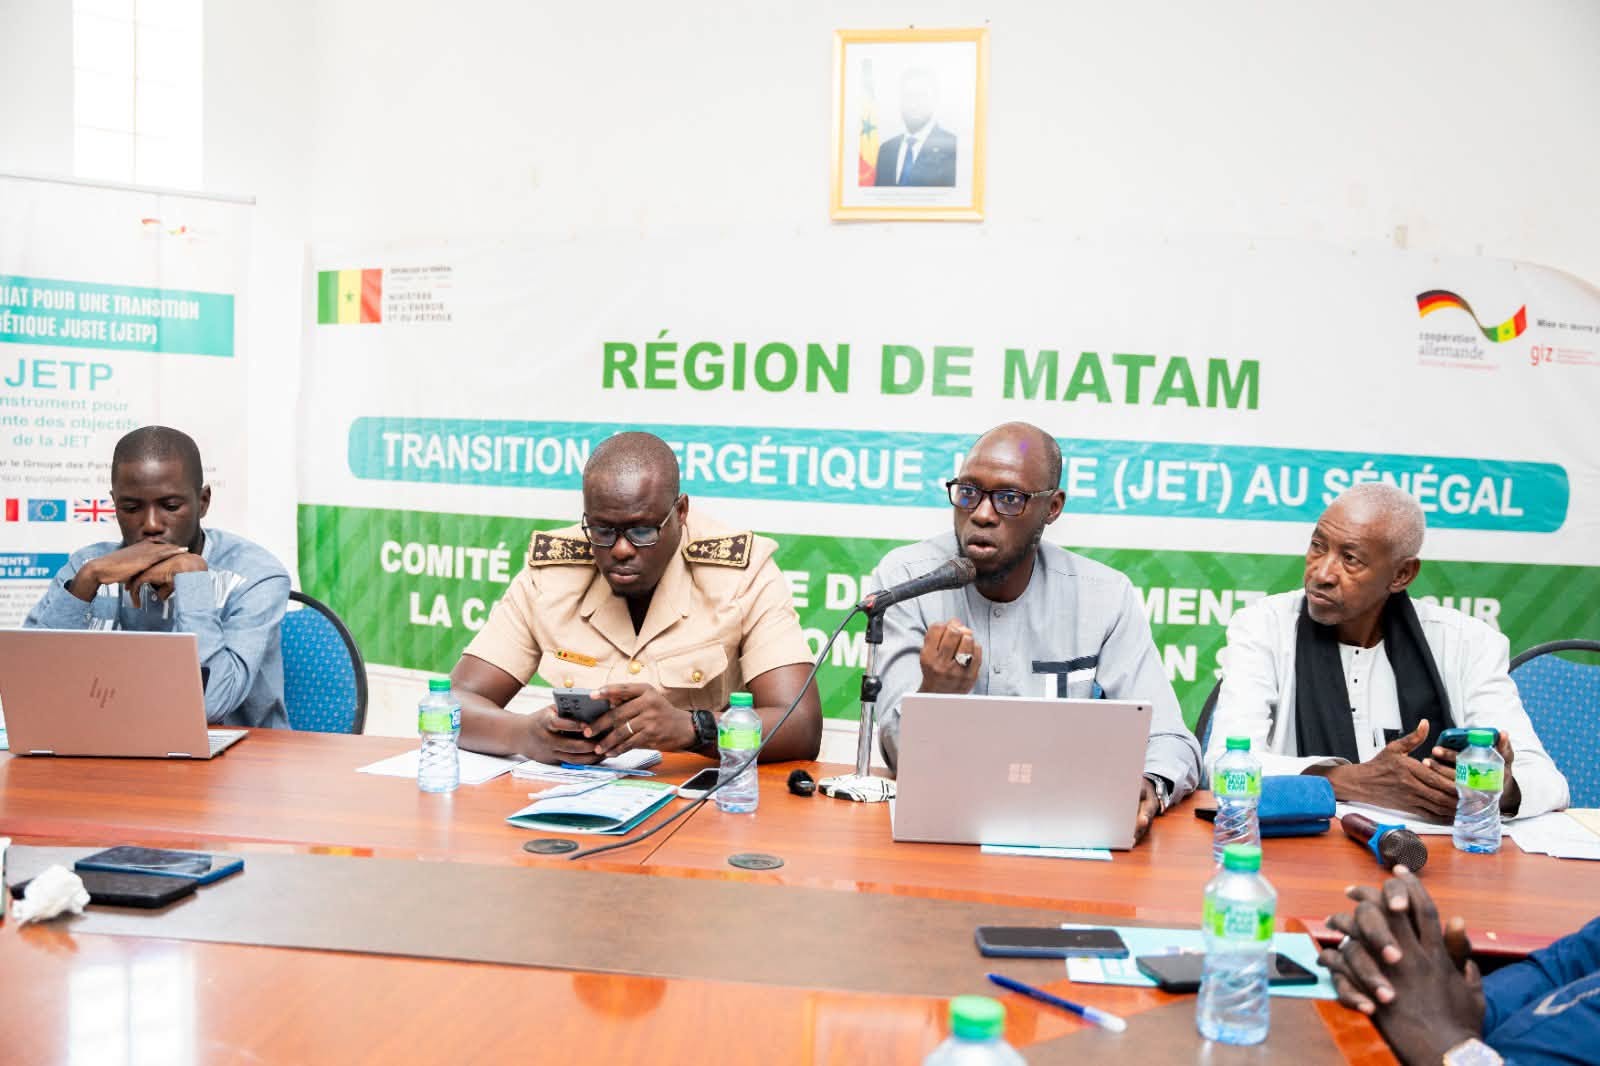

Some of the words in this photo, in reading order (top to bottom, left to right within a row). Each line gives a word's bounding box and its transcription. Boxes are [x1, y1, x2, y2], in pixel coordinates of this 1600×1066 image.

[33, 287, 76, 310] POUR
[79, 292, 111, 314] UNE
[113, 294, 200, 320] TRANSITION
[60, 317, 107, 339] JUSTE
[110, 321, 157, 345] (JETP)
[602, 329, 850, 393] RÉGION
[880, 344, 974, 398] DE
[1002, 348, 1260, 410] MATAM
[1530, 344, 1552, 367] giz
[4, 358, 113, 391] JETP
[34, 415, 64, 427] des
[92, 399, 128, 413] pour
[12, 434, 33, 446] de
[39, 434, 54, 447] la
[58, 435, 91, 448] JET
[382, 432, 590, 475] TRANSITION
[667, 436, 924, 491] RGÉTIQUE
[1113, 459, 1233, 514] (JET)
[1243, 464, 1309, 506] AU
[1322, 461, 1524, 517] SÉGAL
[380, 540, 511, 583] COMITÉ
[409, 592, 452, 628] LA
